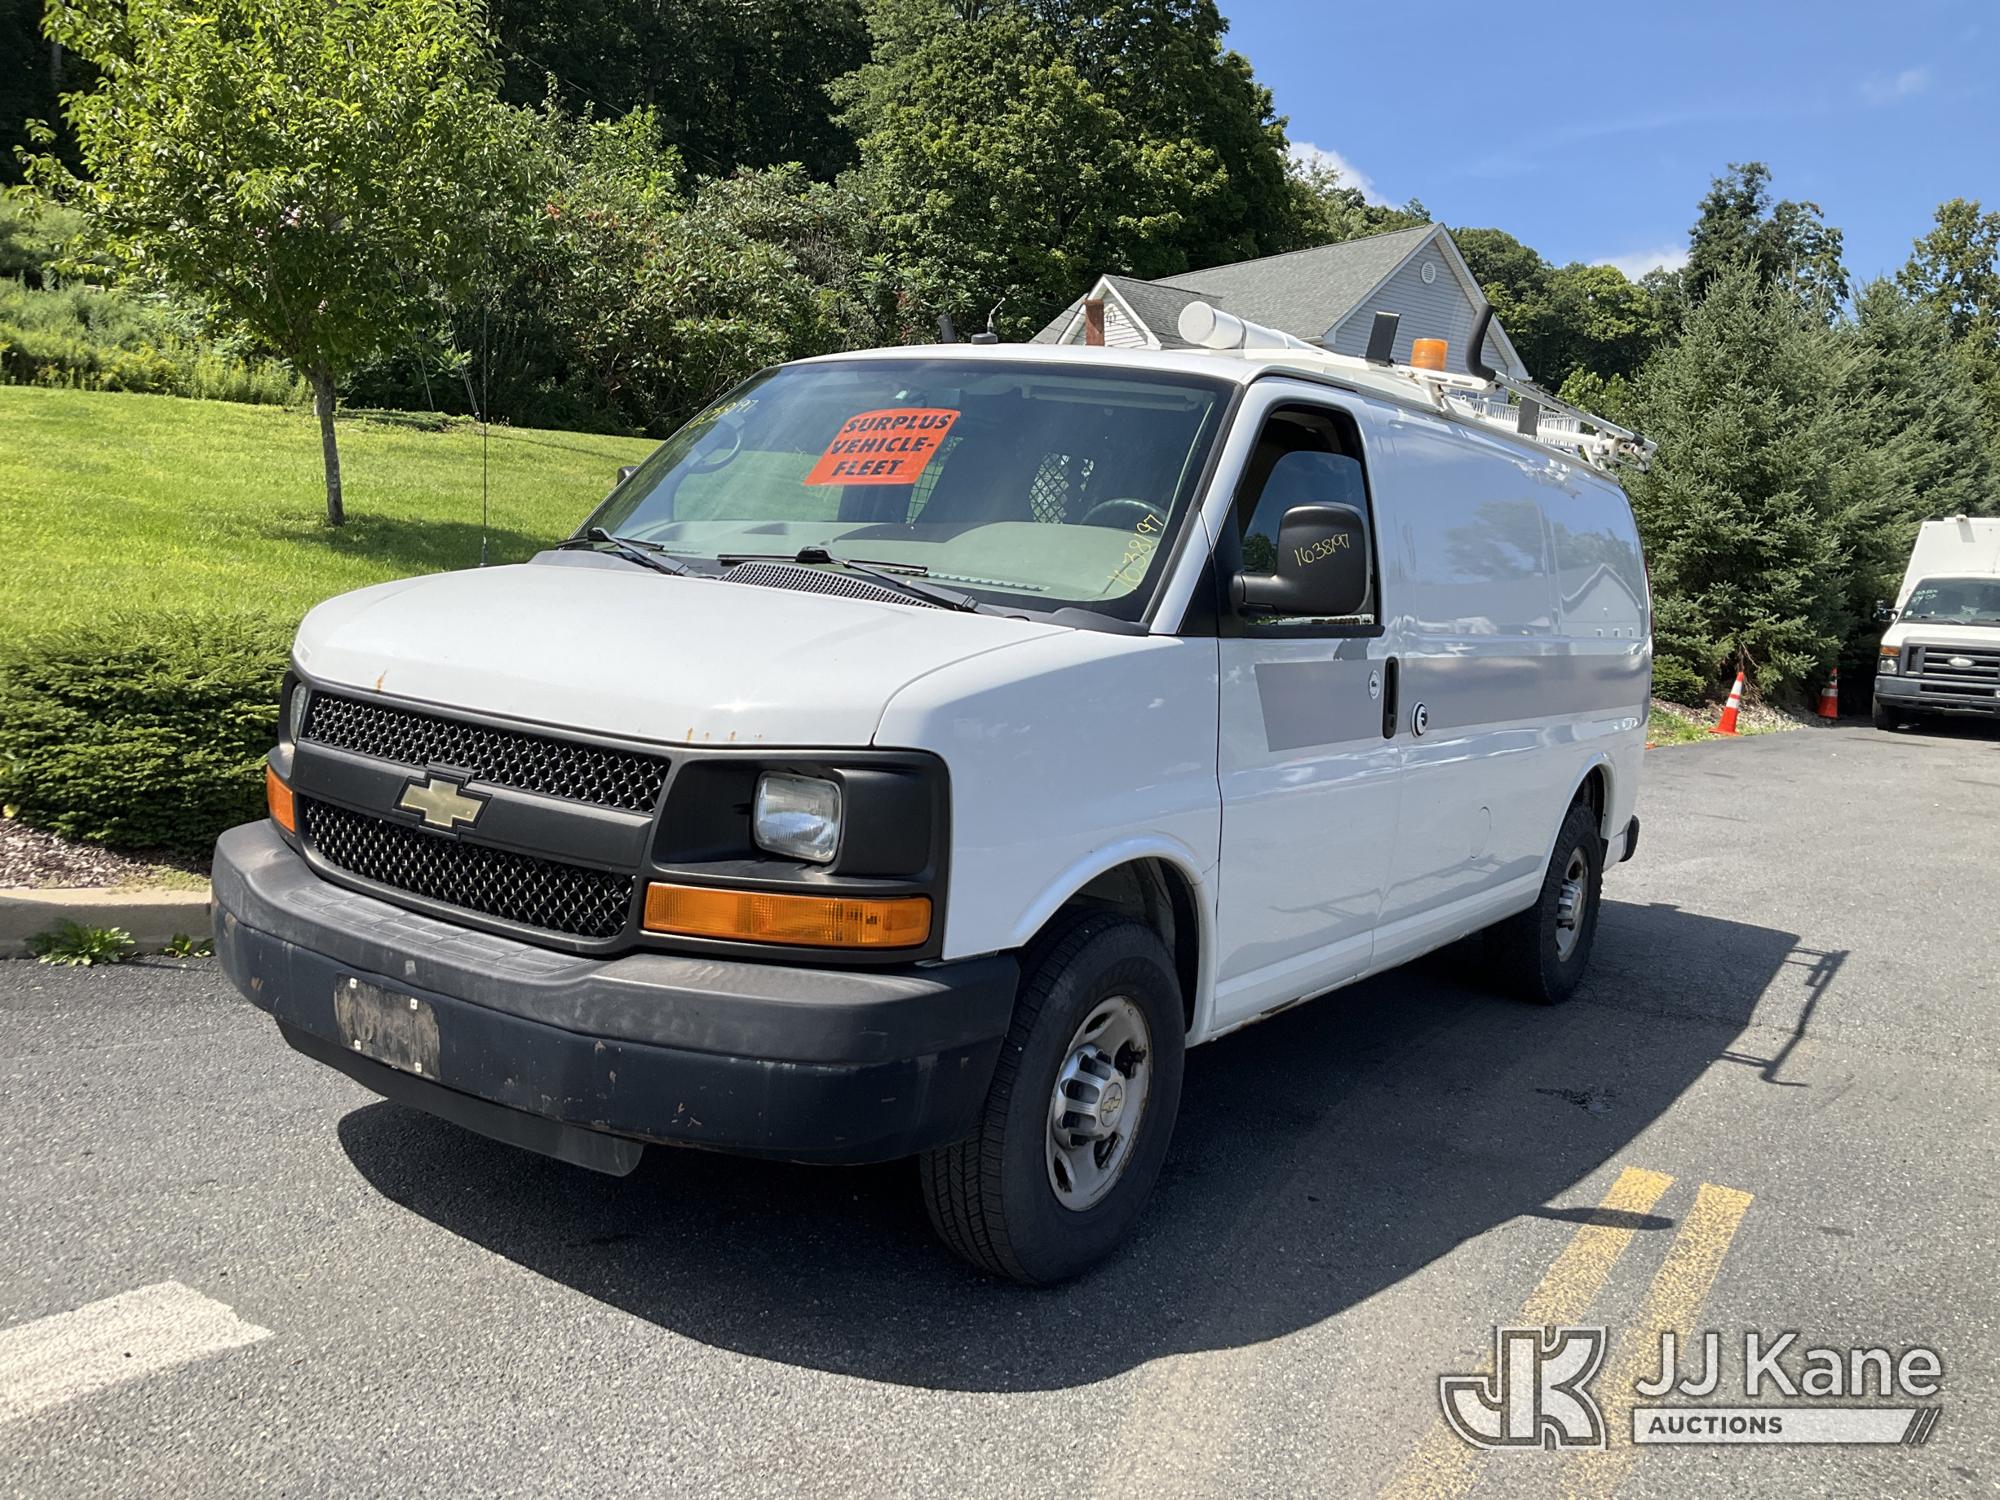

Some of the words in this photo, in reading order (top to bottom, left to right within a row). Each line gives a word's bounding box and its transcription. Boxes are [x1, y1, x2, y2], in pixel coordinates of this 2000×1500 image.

[844, 414, 952, 433] SURPLUS
[831, 459, 905, 477] FLEET
[1294, 533, 1350, 567] 1638197
